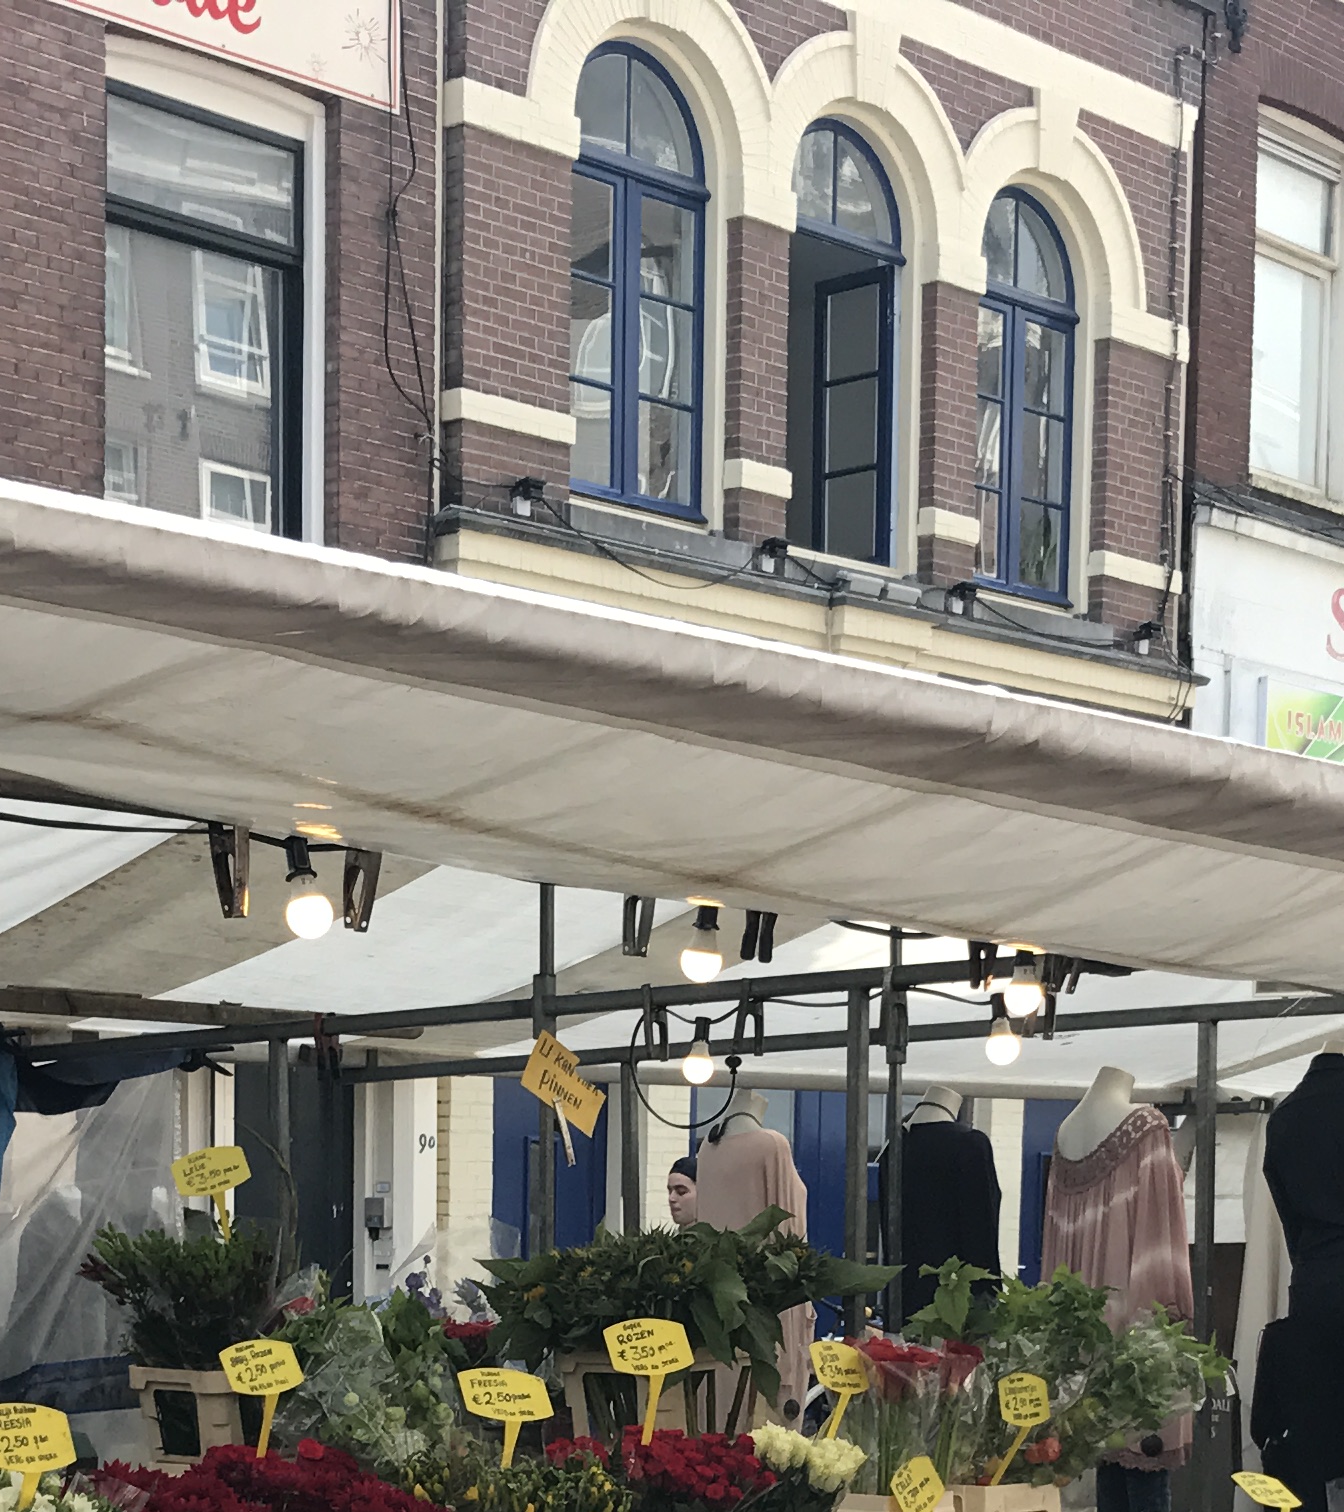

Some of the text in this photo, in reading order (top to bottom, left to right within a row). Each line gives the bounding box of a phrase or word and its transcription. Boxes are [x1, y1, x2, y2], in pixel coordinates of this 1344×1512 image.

[538, 1038, 554, 1058] U
[419, 1133, 436, 1154] 90
[616, 1329, 655, 1346] ROZEN
